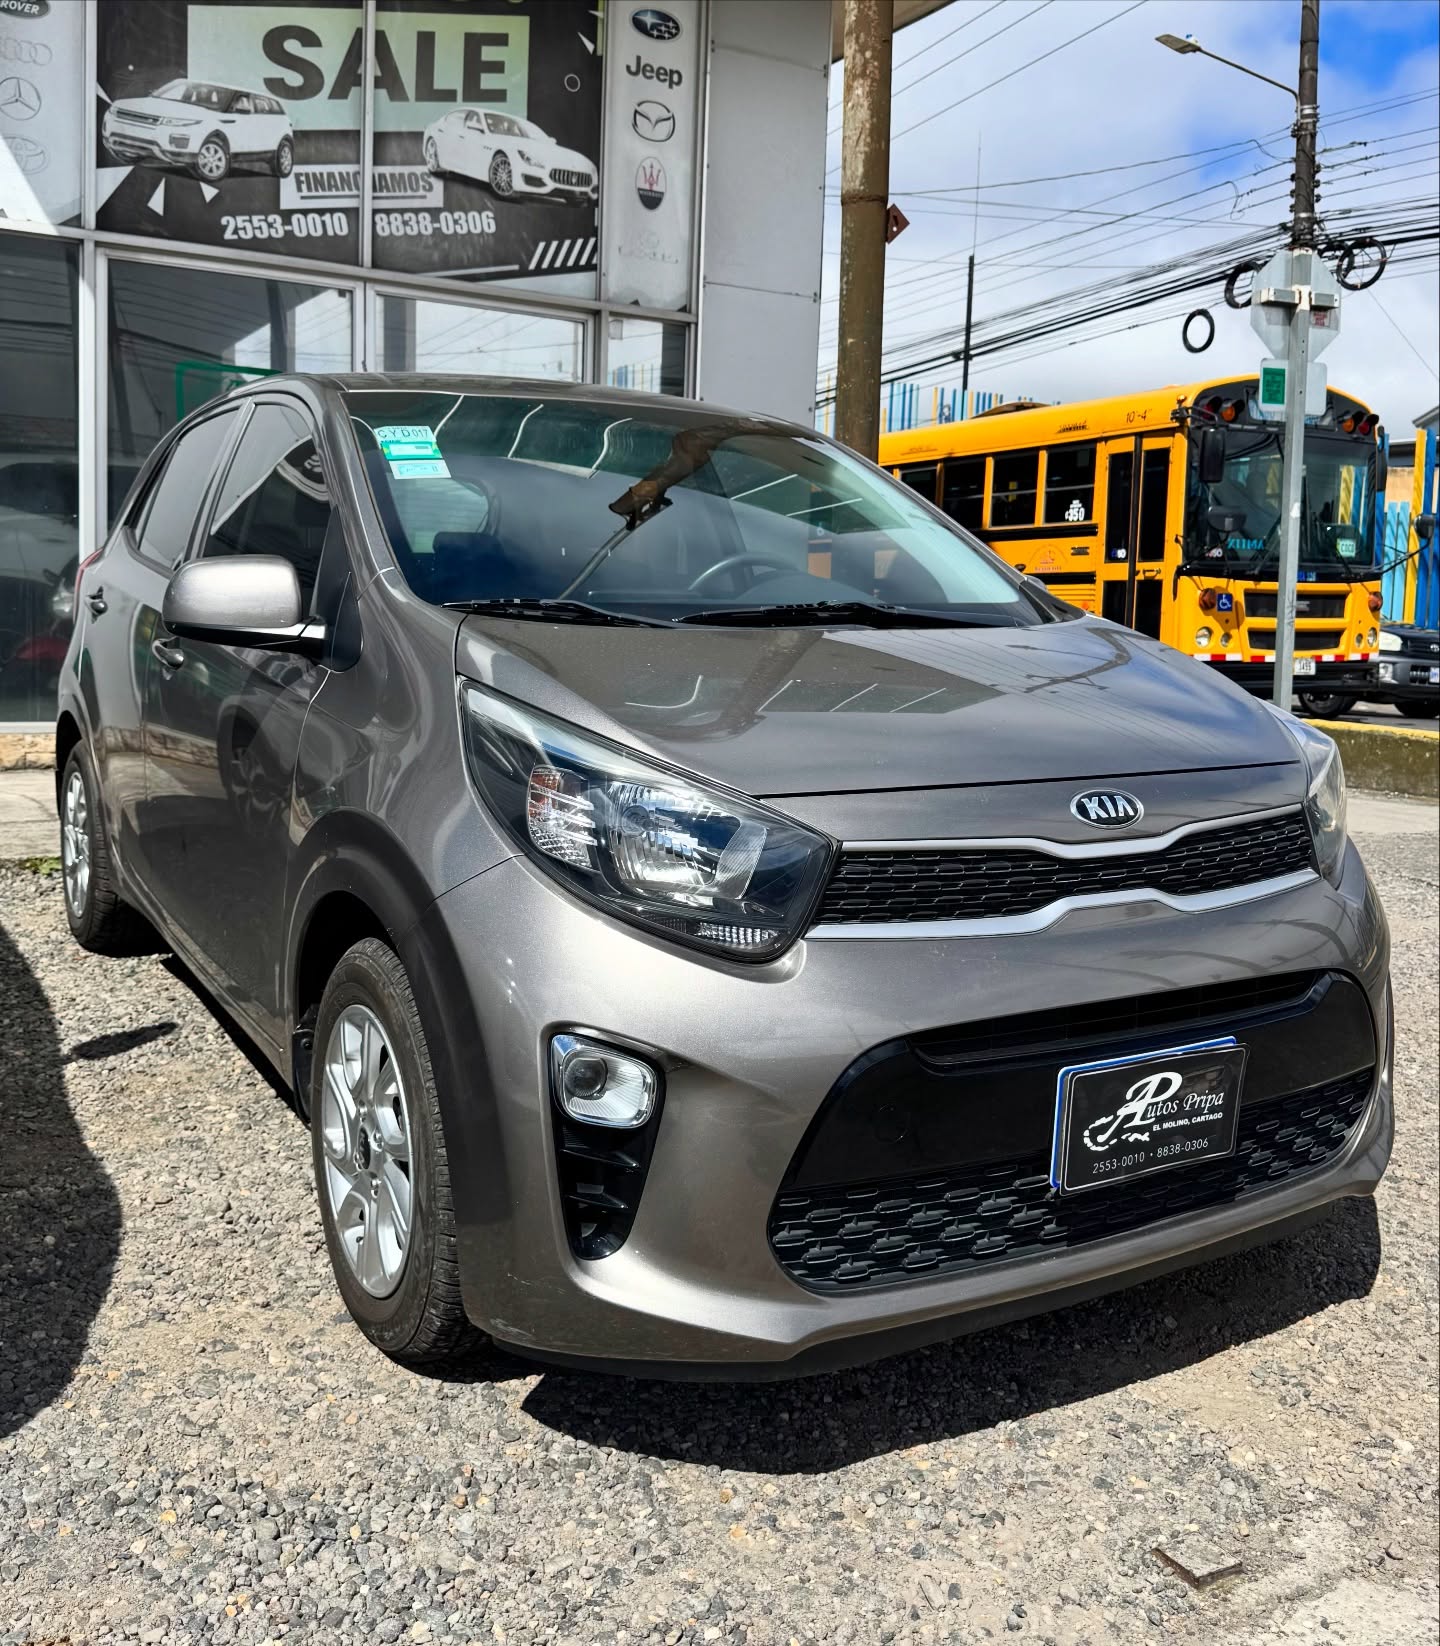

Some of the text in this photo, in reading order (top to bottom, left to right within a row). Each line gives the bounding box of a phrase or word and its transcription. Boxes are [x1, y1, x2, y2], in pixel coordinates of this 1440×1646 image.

[0, 0, 40, 15] ROVER
[262, 25, 510, 103] SALE
[625, 56, 683, 89] Jeep
[221, 211, 497, 240] 2553-0010 8838-0306
[1080, 795, 1136, 820] KIA
[1183, 1090, 1225, 1114] Pripa
[1152, 1112, 1223, 1132] EL MOLINO, CARTAGO
[1092, 1138, 1209, 1174] 2553-0010 8838-0306
